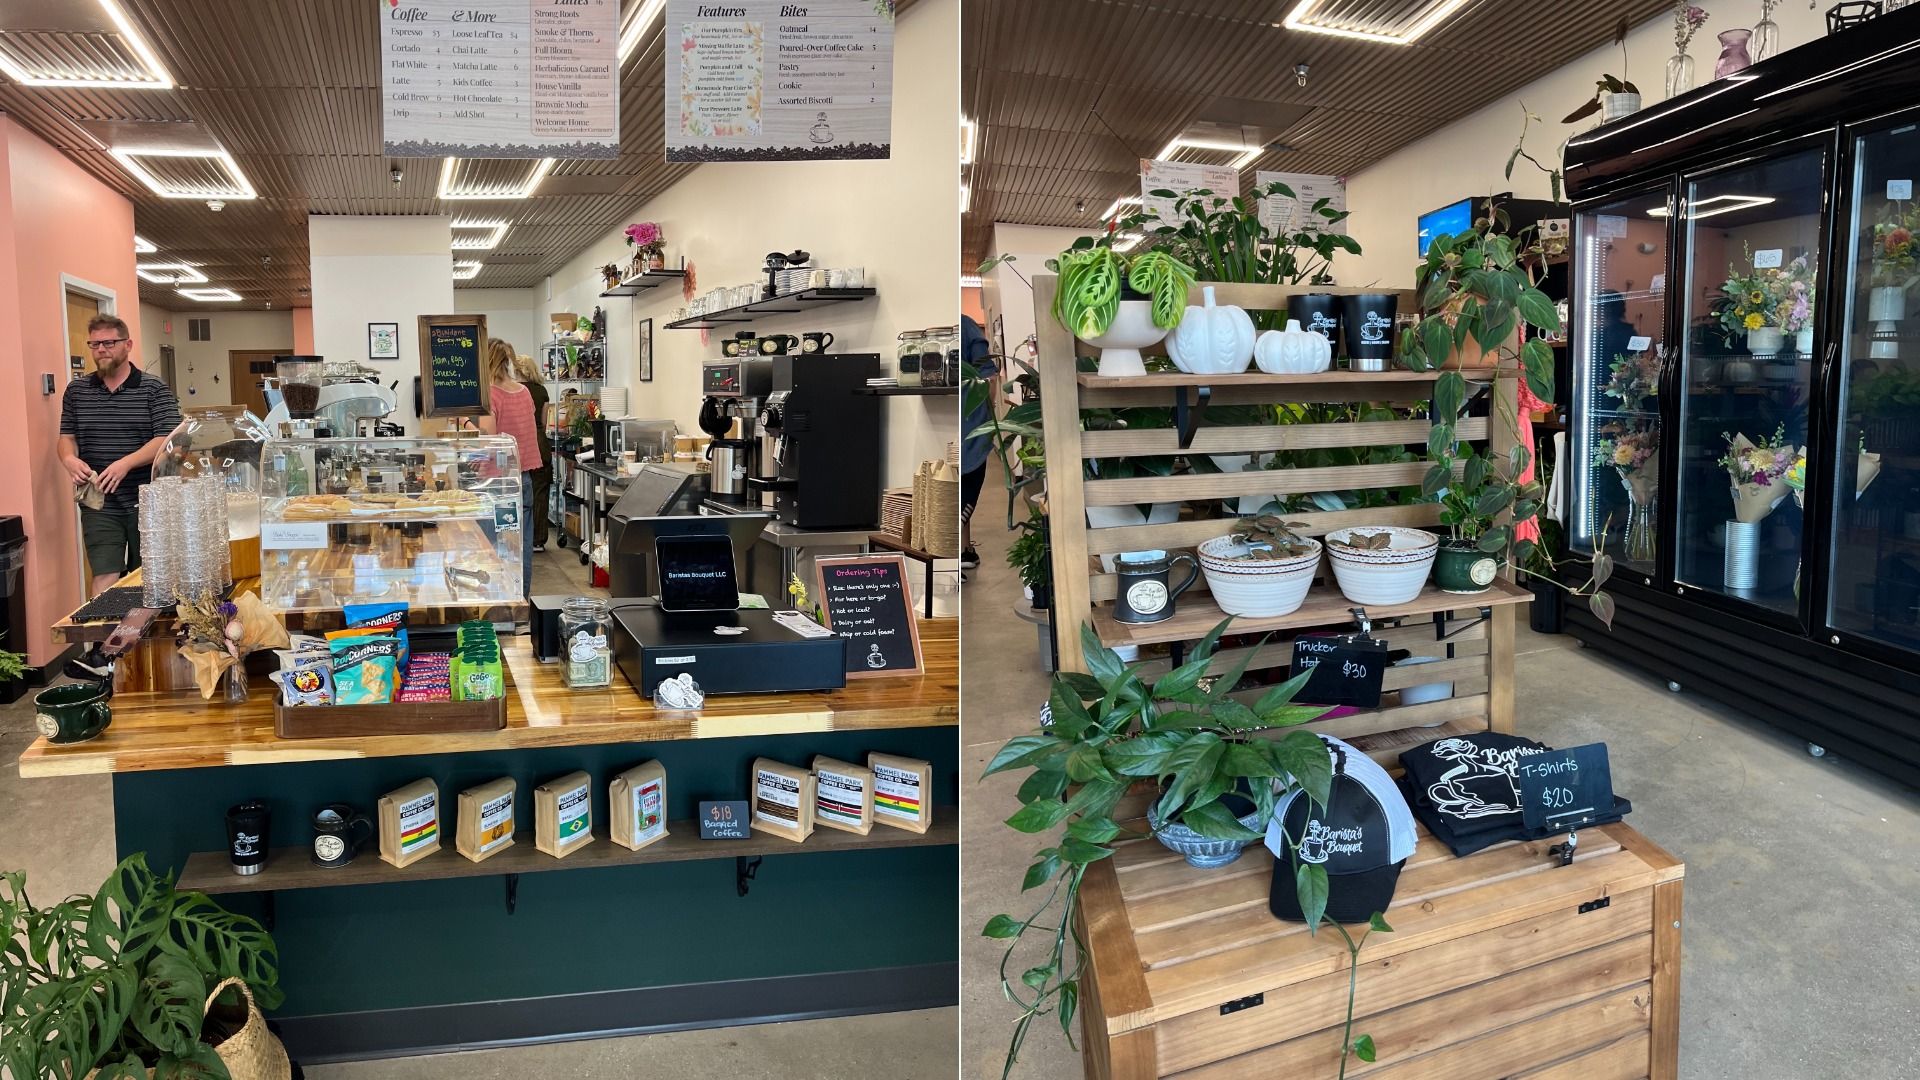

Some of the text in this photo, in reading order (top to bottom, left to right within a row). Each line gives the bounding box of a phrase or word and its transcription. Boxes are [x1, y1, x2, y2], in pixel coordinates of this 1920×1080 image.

[391, 8, 428, 23] Coffee
[534, 10, 580, 18] Strong Roots
[697, 5, 747, 17] Features
[780, 5, 808, 17] Bites
[451, 10, 497, 23] & More
[391, 28, 423, 36] Espresso
[452, 30, 472, 38] Loose
[474, 30, 490, 38] Leaf
[534, 28, 559, 36] Smoke
[391, 44, 420, 52] Cortado
[452, 46, 468, 54] Chai
[470, 46, 488, 54] Latte
[535, 46, 573, 54] Full Bloom
[780, 44, 823, 52] Poured-Over
[392, 60, 404, 69] Flat
[406, 60, 428, 69] White
[452, 62, 478, 70] Matcha
[480, 63, 498, 71] Latte
[580, 65, 609, 73] Caramel
[392, 77, 410, 85] Latte
[453, 78, 469, 86] Kids
[470, 79, 493, 87] Coffee
[536, 82, 582, 90] House Vanilla
[392, 93, 410, 101] Cold
[410, 93, 430, 101] Brew
[453, 94, 466, 102] Hot
[468, 94, 502, 103] Chocolate
[808, 96, 833, 104] Biscotti
[393, 109, 410, 118] Drip
[453, 110, 468, 118] Add
[469, 110, 485, 118] Shot
[536, 118, 567, 126] Welcome
[872, 568, 888, 578] Tips
[1296, 640, 1338, 653] Trucker
[1300, 656, 1318, 668] Hat
[1342, 660, 1366, 678] $30
[470, 672, 490, 683] GoGo
[876, 766, 900, 777] PAMMEL
[1521, 757, 1578, 778] T-Shirts
[760, 773, 781, 783] PAMMEL
[820, 773, 862, 786] PAMMEL PARK
[877, 774, 894, 782] COFFEE
[760, 779, 776, 788] COFFEE
[821, 779, 838, 788] COFFEE
[560, 787, 587, 803] PAMMEL PARK
[1542, 787, 1574, 808] $20
[401, 794, 434, 812] PAMMEL PARK
[483, 794, 511, 811] PAMMEL PARK
[560, 800, 574, 810] COFFEE
[403, 808, 417, 818] COFFEE
[483, 808, 496, 818] COFFEE
[712, 806, 732, 822] $18
[713, 829, 742, 837] Coffee
[1320, 826, 1362, 841] Barista's
[1327, 841, 1363, 856] Bouquet
